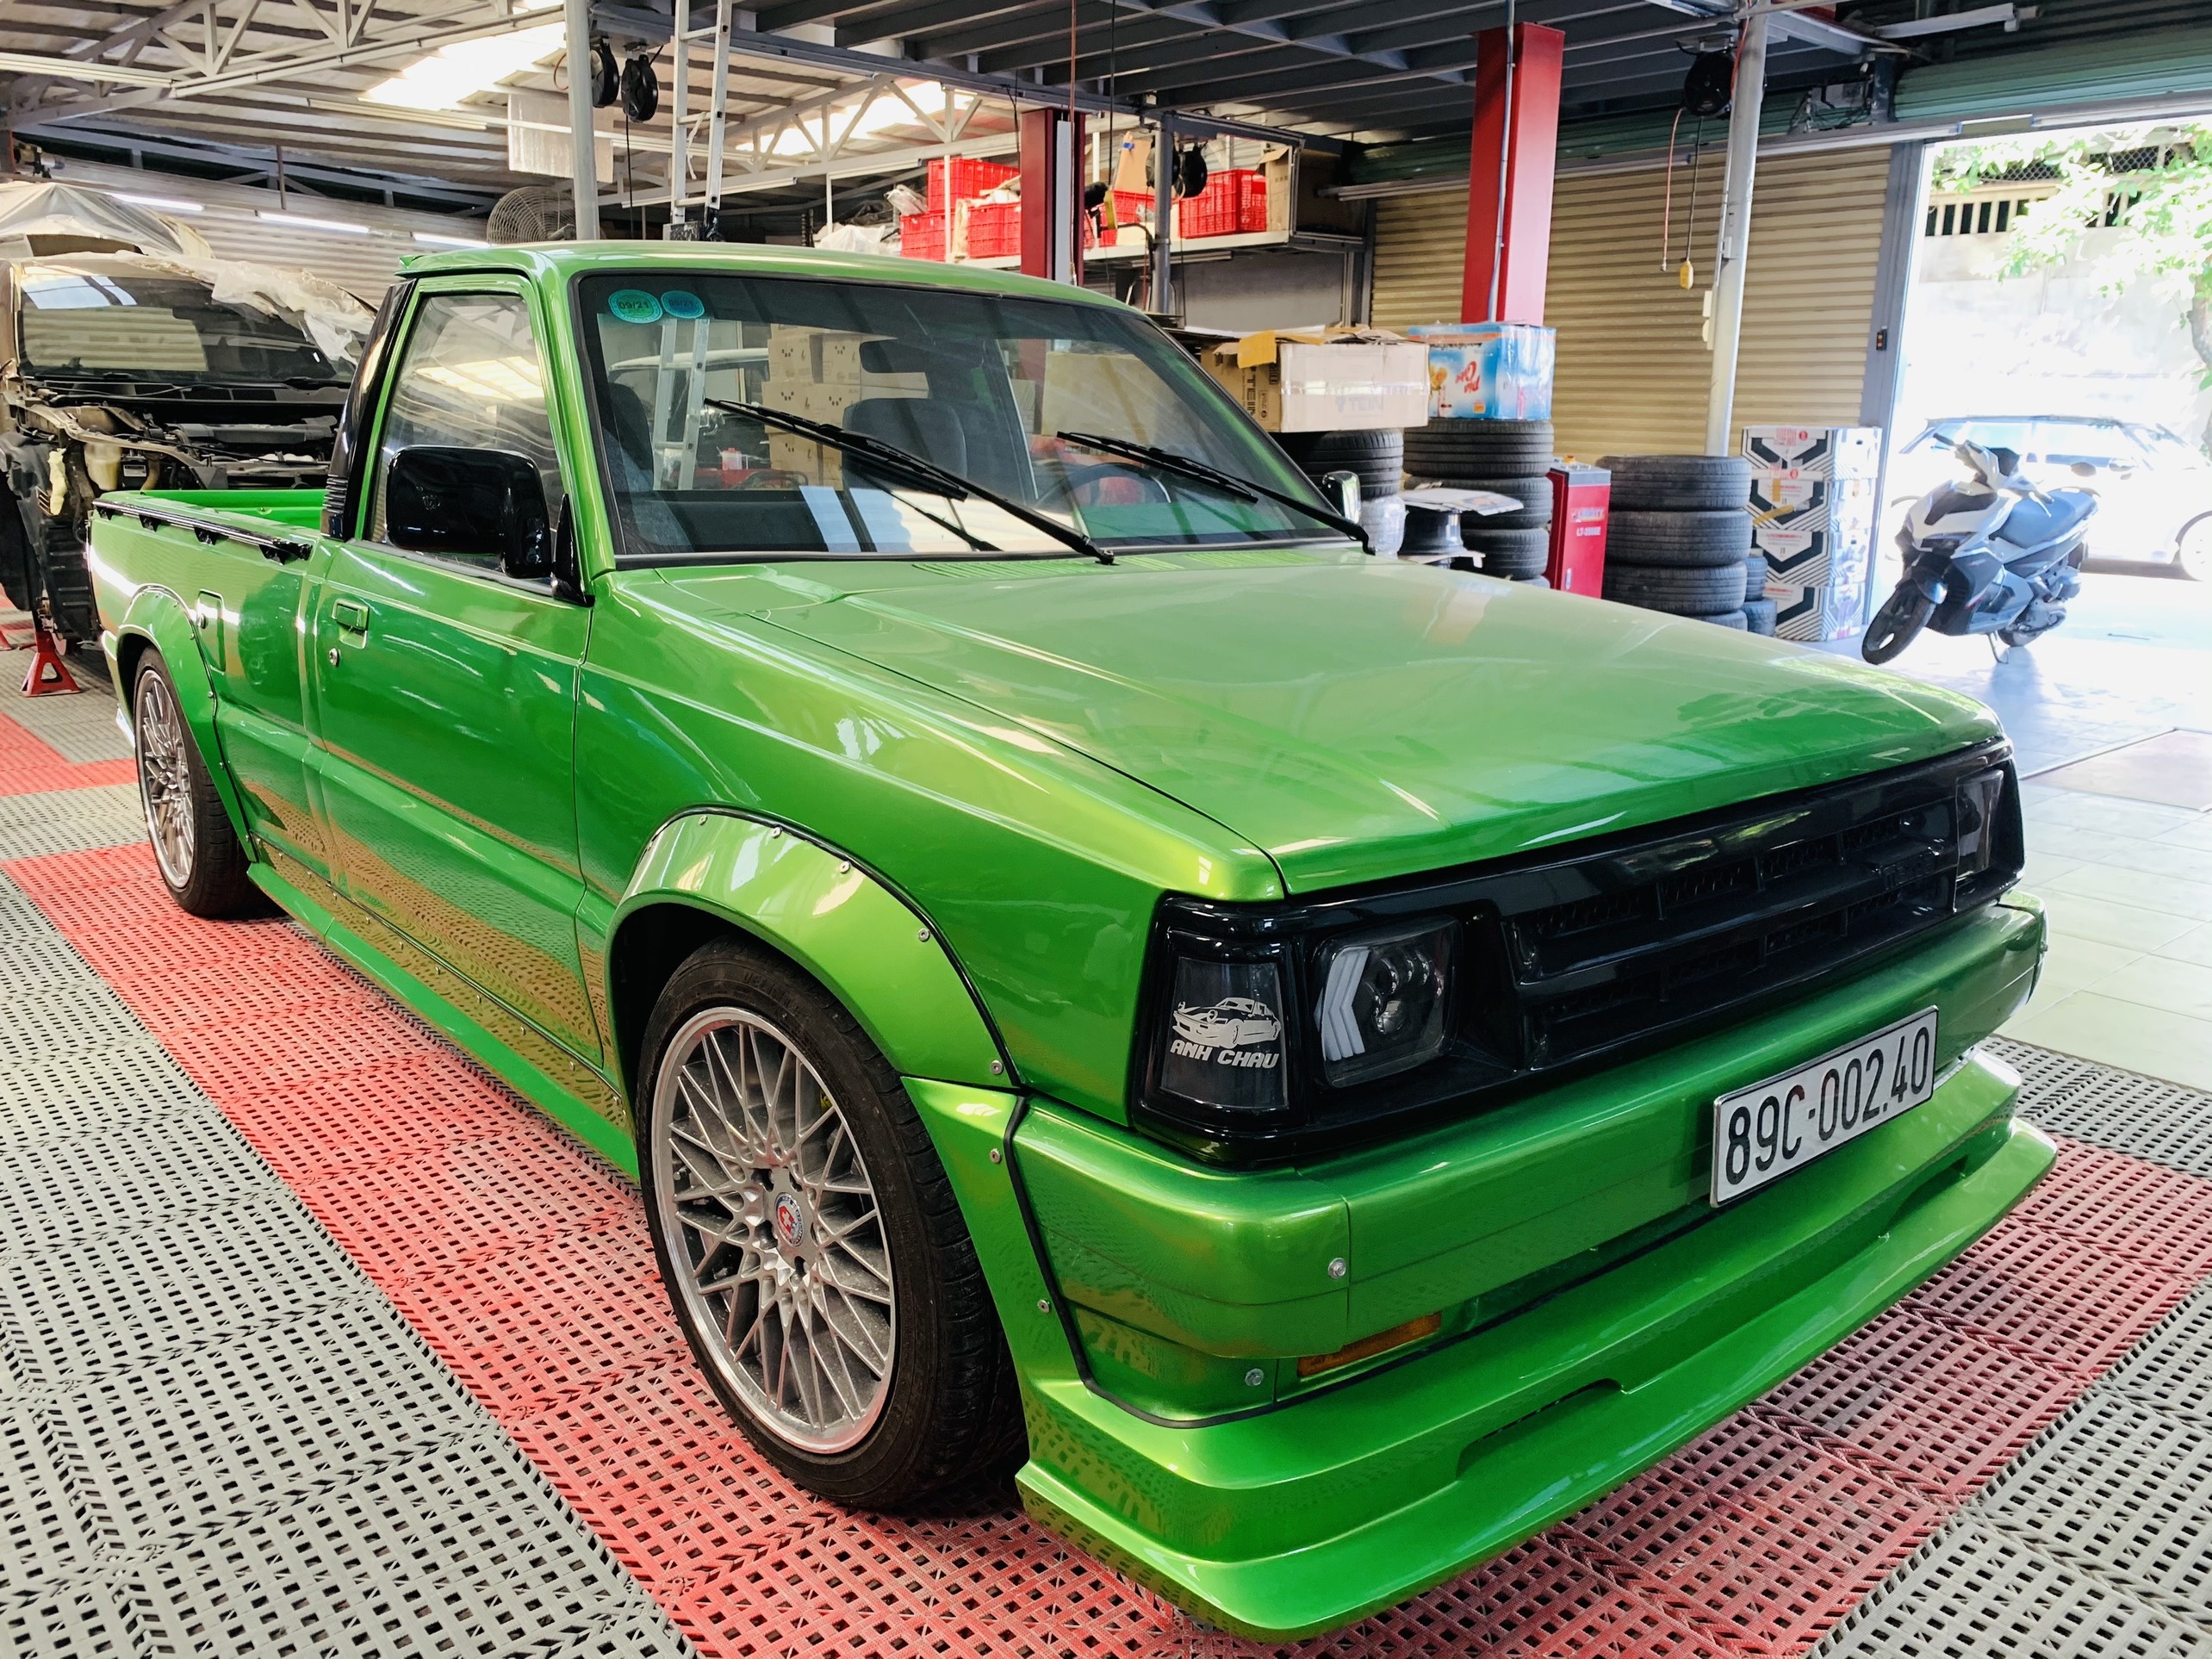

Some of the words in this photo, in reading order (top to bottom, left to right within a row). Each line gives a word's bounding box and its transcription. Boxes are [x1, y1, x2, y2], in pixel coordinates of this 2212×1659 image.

[1170, 1040, 1213, 1061] ANH
[1217, 1049, 1280, 1069] CHAU
[1725, 1027, 1930, 1186] 89C-002.40
